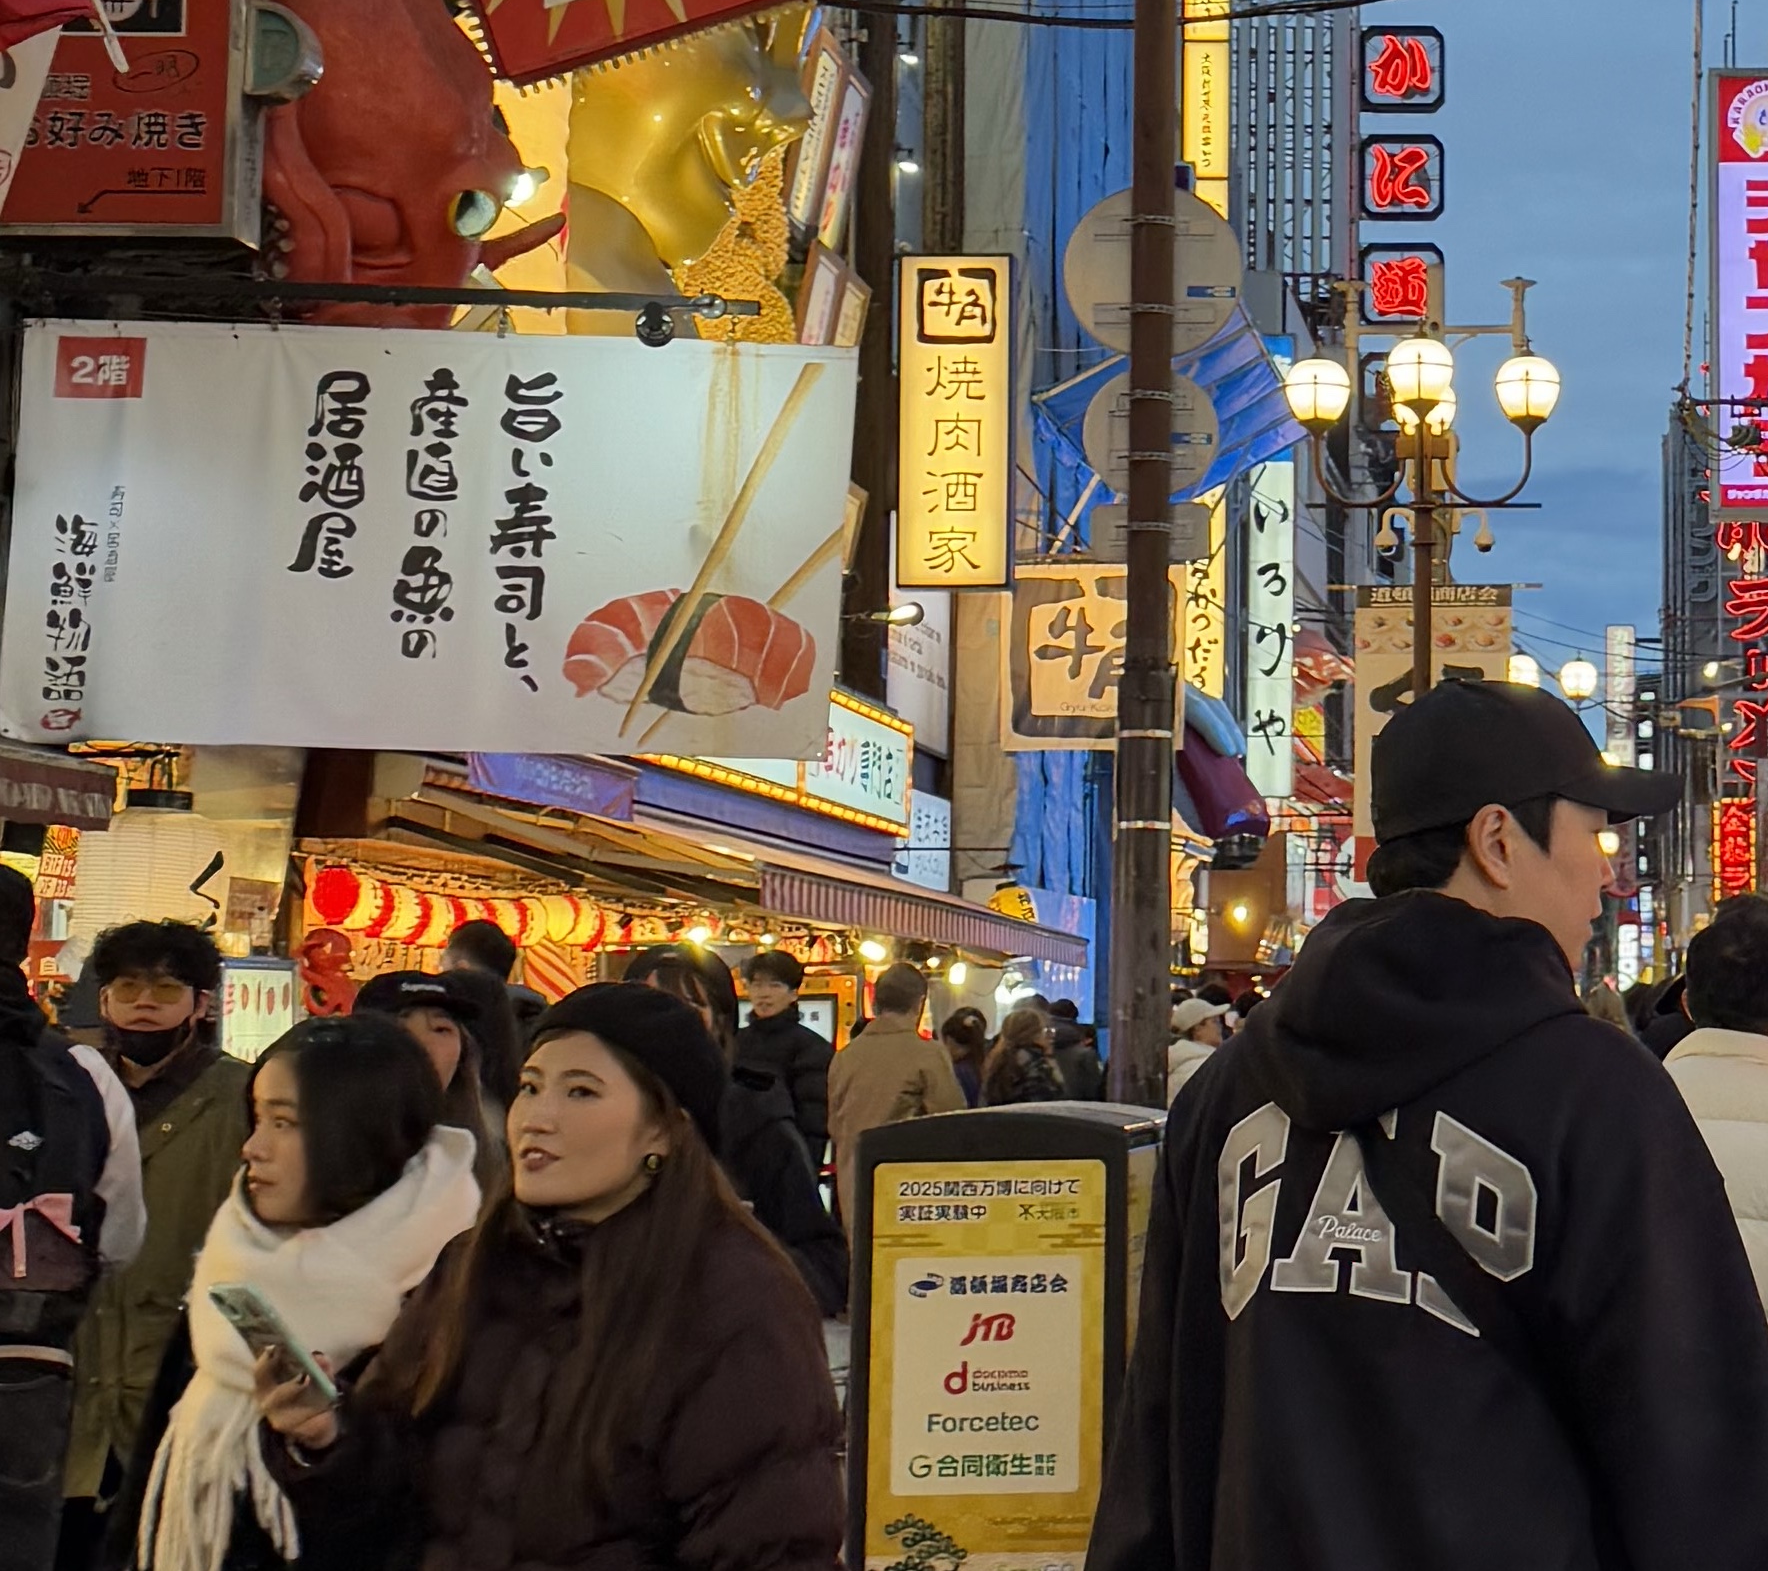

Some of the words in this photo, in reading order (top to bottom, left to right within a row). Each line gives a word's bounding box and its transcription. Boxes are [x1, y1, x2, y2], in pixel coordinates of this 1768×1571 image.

[926, 282, 991, 329] 牛角
[69, 355, 131, 387] 2階
[288, 370, 371, 580] 居酒屋
[922, 355, 987, 574] 焼肉酒家
[390, 367, 470, 661] 産直の魚の
[490, 372, 565, 694] 旨い寿司と、
[1370, 586, 1499, 603] 道頓商店会
[1250, 496, 1290, 757] いろりや
[898, 1178, 1081, 1197] 2025関西万博に向けて
[1318, 1215, 1383, 1243] Palace
[926, 1411, 1040, 1433] Forcetec
[937, 1452, 1033, 1477] 合同衛生
